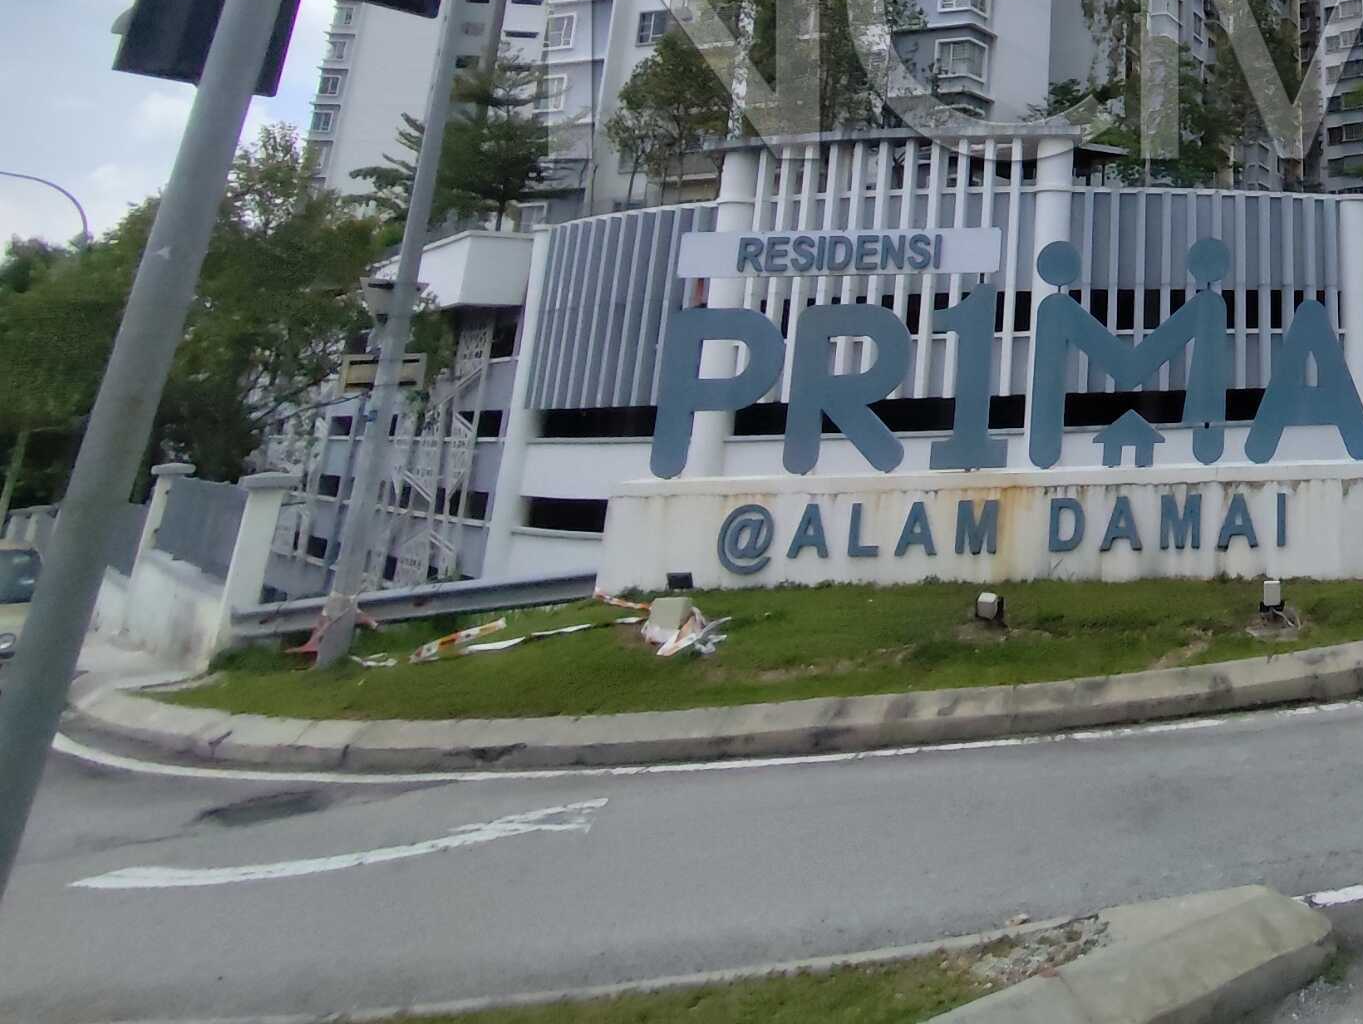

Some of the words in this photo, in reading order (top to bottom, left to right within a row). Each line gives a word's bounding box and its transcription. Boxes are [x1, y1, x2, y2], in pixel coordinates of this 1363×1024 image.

[736, 233, 943, 273] RESIDENSI
[716, 498, 998, 575] @ALAM
[1047, 492, 1289, 553] DAMAI
